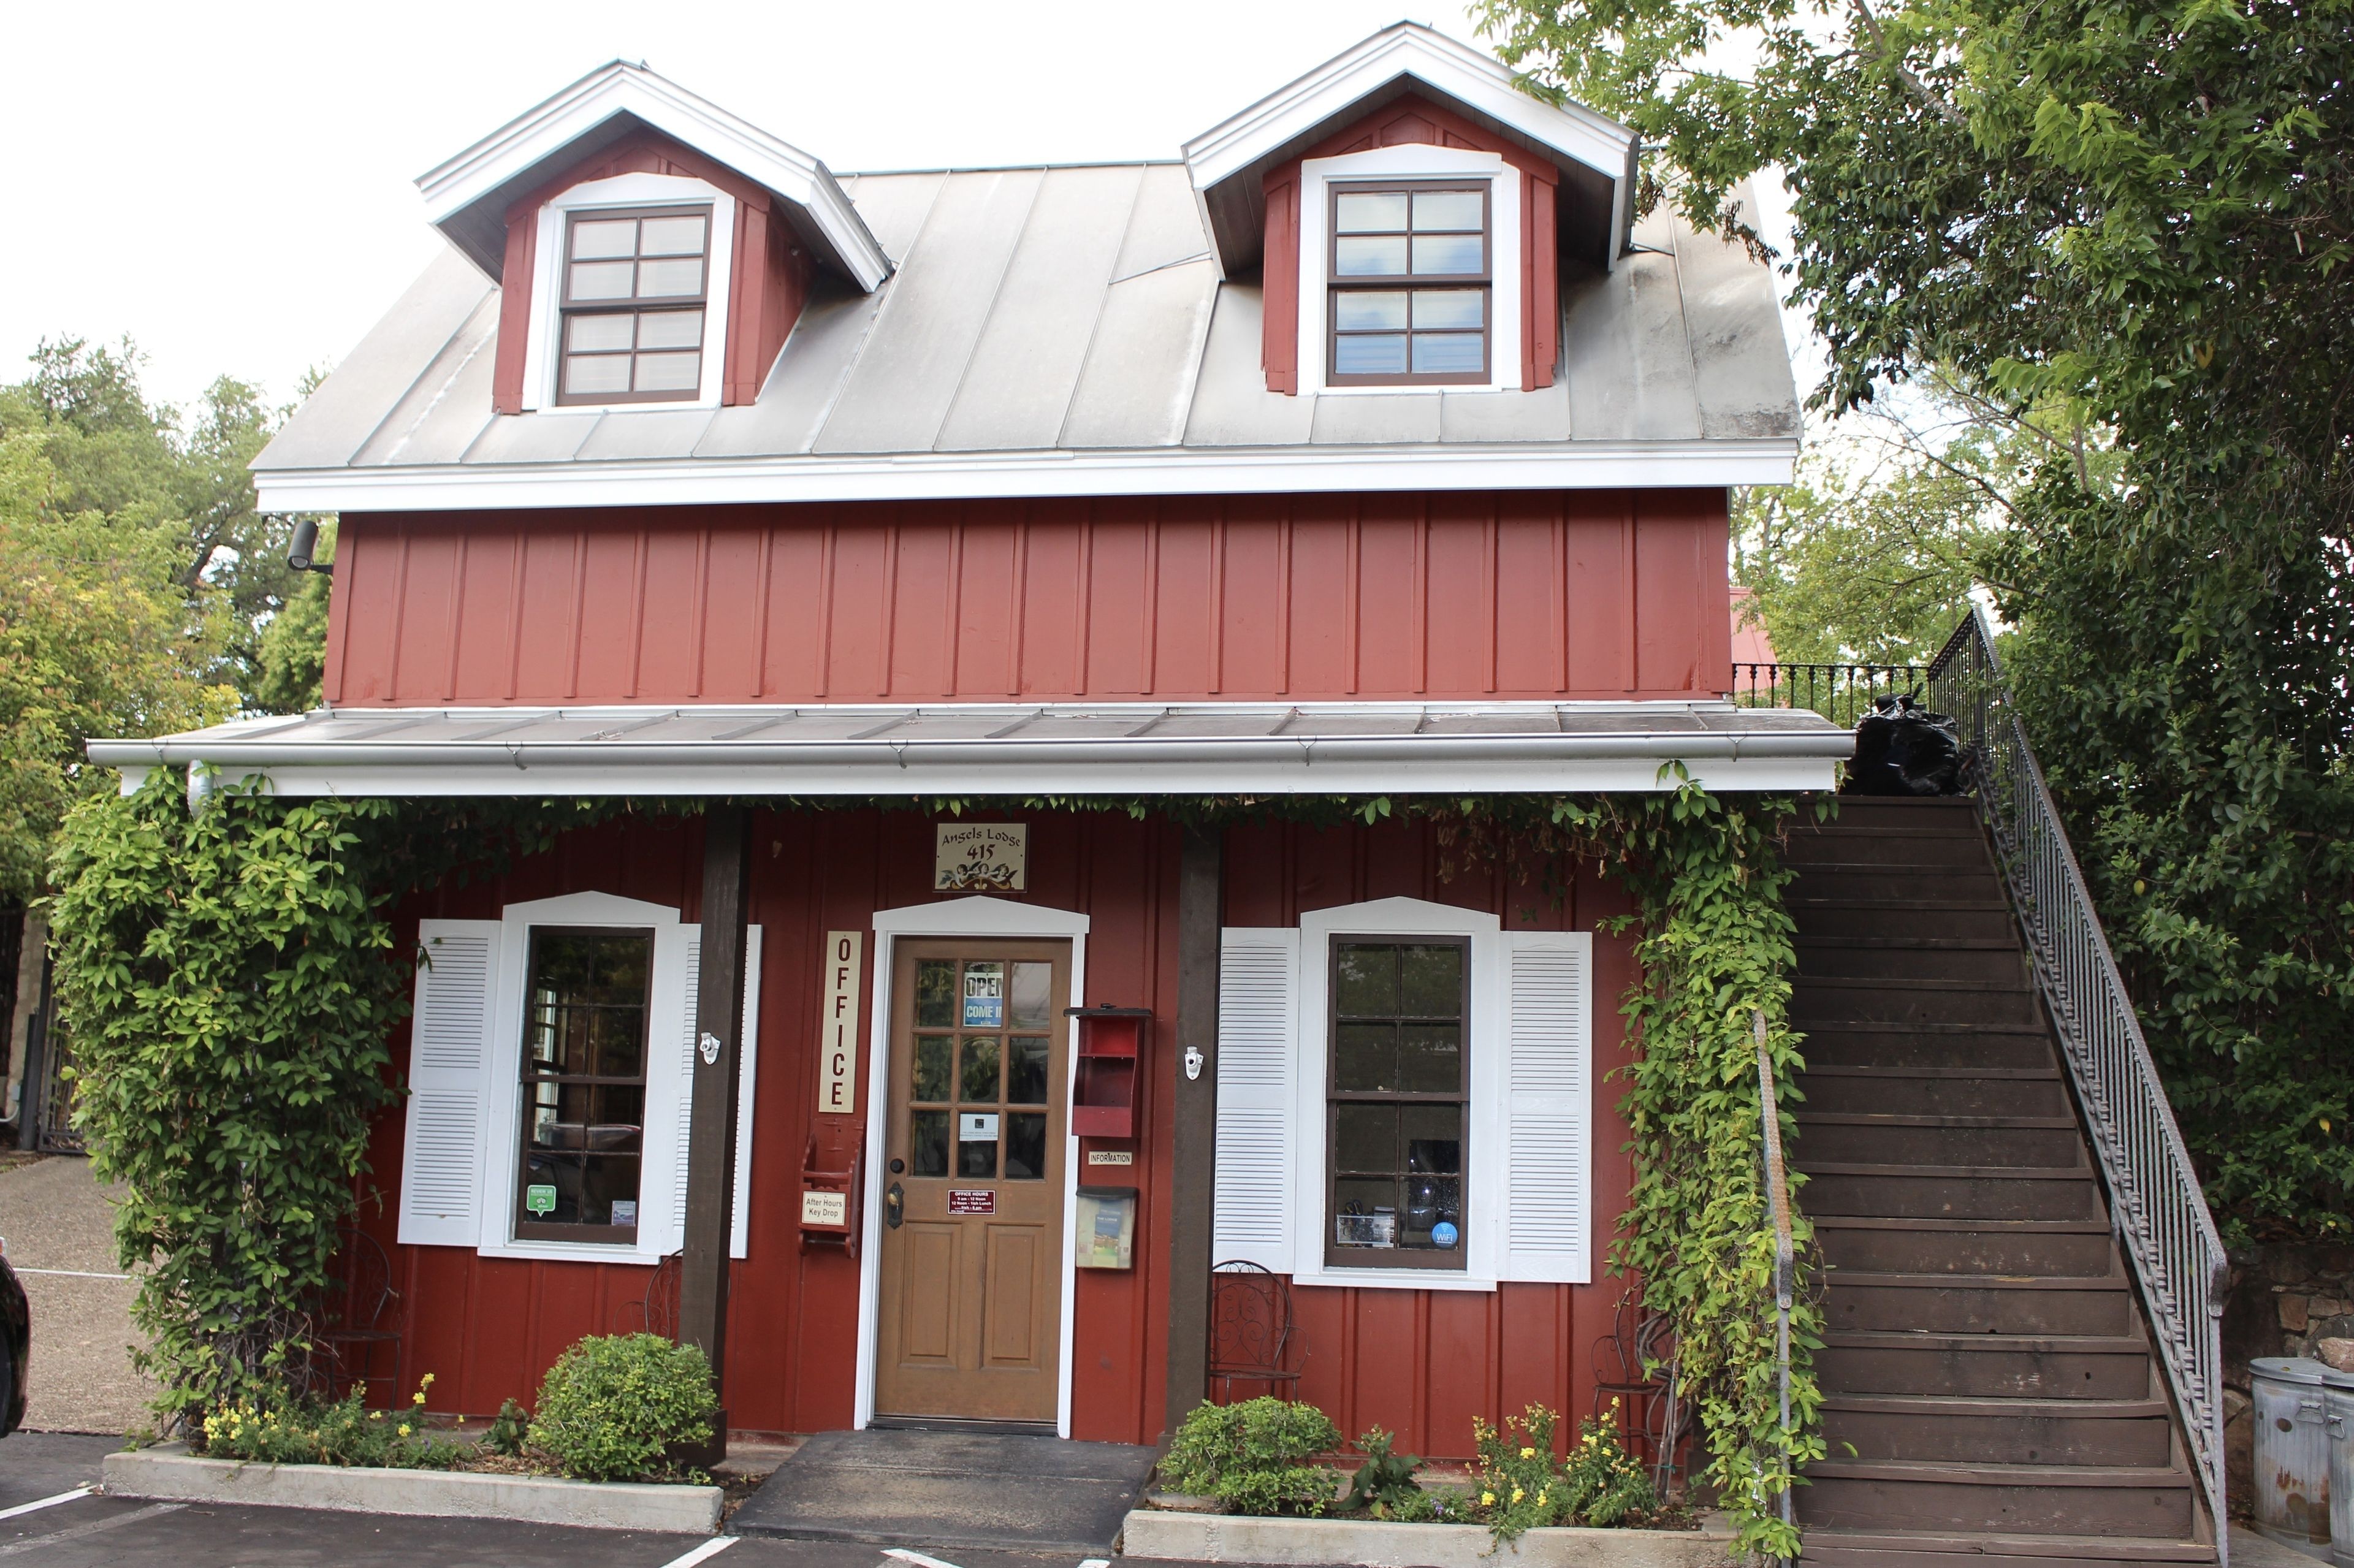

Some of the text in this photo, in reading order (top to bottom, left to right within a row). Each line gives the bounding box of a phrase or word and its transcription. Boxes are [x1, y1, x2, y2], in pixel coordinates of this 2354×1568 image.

[942, 827, 1020, 847] Angels Lodge
[967, 844, 996, 861] 415
[966, 1006, 993, 1018] COME
[831, 938, 851, 1105] OFFICE
[806, 1198, 842, 1208] After Hours
[809, 1208, 838, 1218] Key Drop
